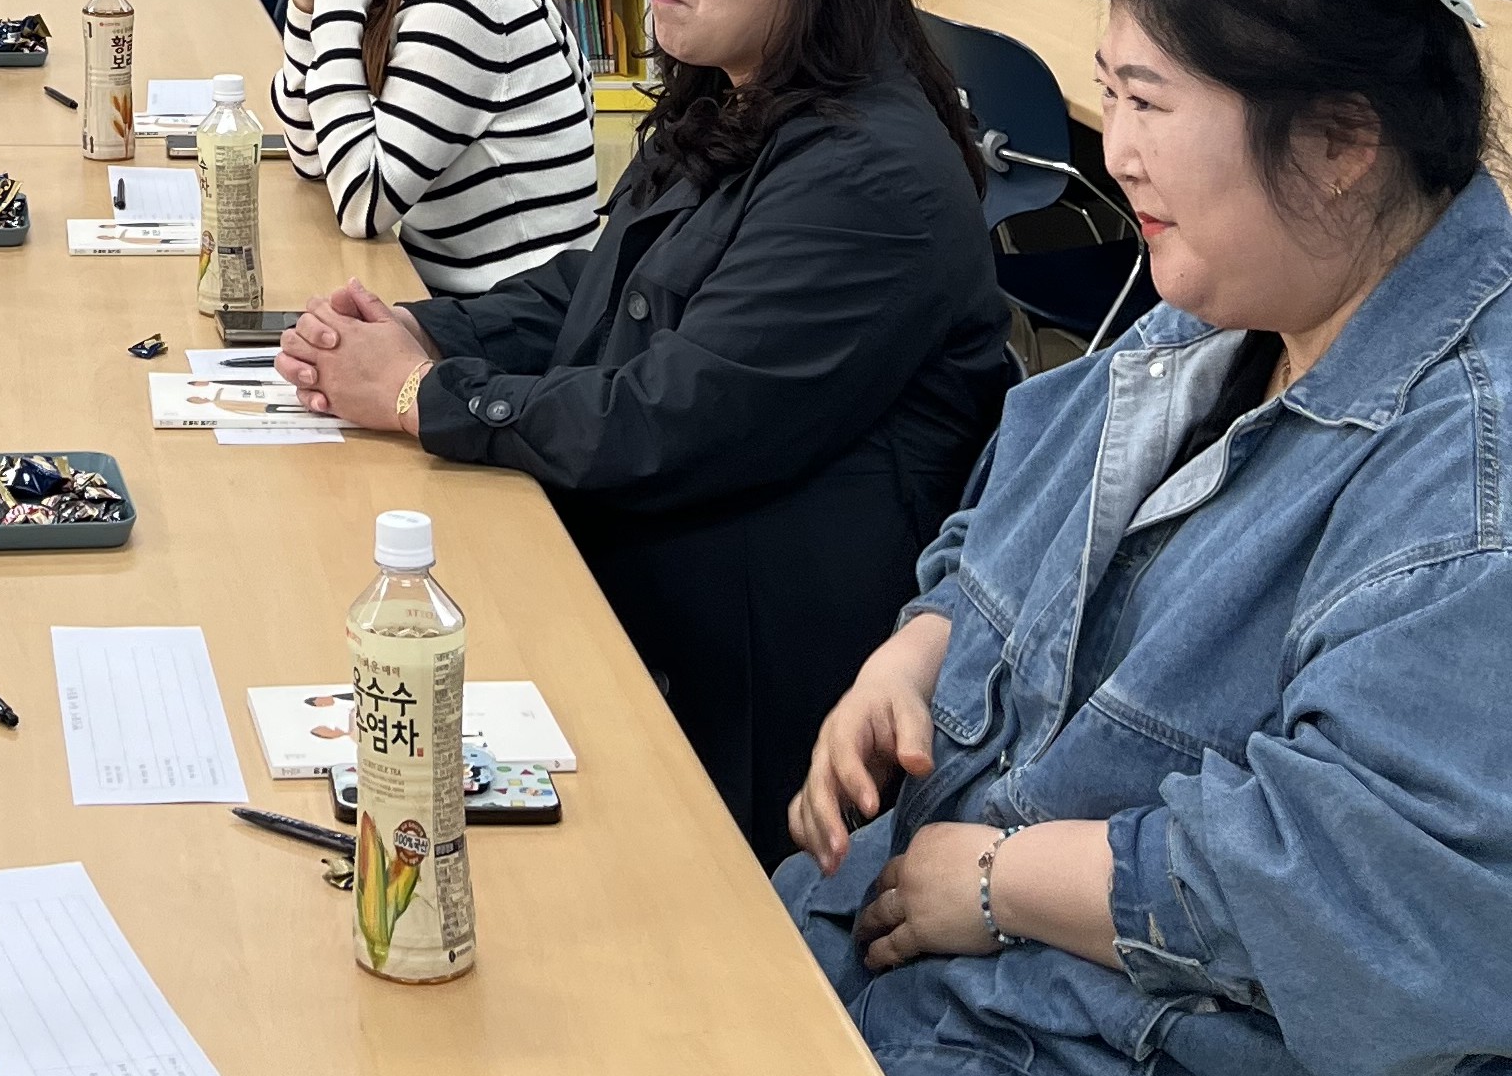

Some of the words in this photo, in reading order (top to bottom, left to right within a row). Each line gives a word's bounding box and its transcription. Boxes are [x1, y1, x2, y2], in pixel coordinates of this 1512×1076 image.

[353, 666, 417, 717] 옥수수
[355, 712, 419, 757] 수염차
[389, 767, 402, 777] TEA
[394, 831, 429, 853] 100%국산
